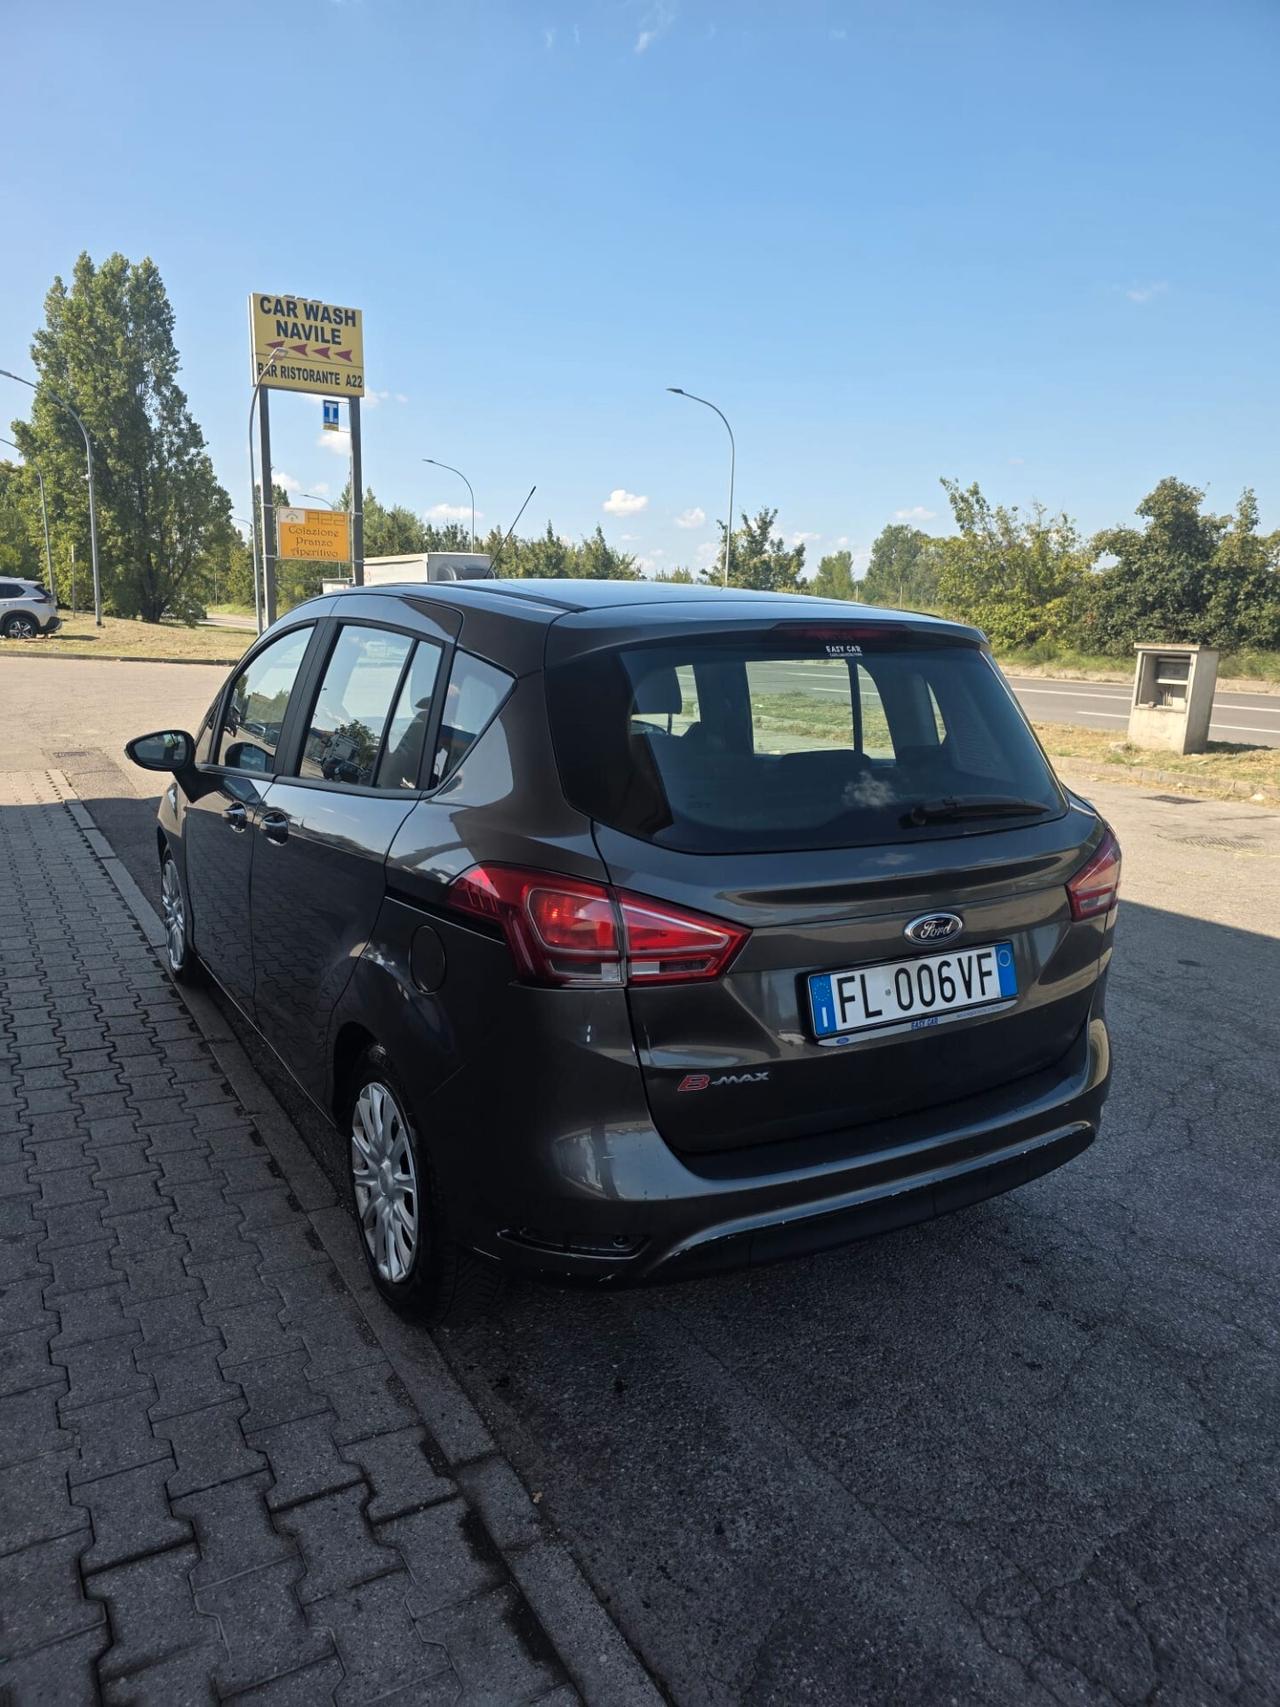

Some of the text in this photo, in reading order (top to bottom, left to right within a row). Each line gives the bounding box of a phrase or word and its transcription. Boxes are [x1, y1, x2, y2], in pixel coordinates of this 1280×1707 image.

[260, 297, 356, 327] CAR WASH
[276, 320, 341, 345] NAVILE
[280, 365, 340, 385] RISTORANTE
[346, 374, 362, 388] A22
[308, 511, 346, 527] A22
[296, 537, 333, 547] Pranzo
[290, 547, 338, 557] Aperitivo
[825, 645, 844, 653] EASY
[920, 920, 953, 939] Ford
[836, 952, 993, 1024] FL 006VF
